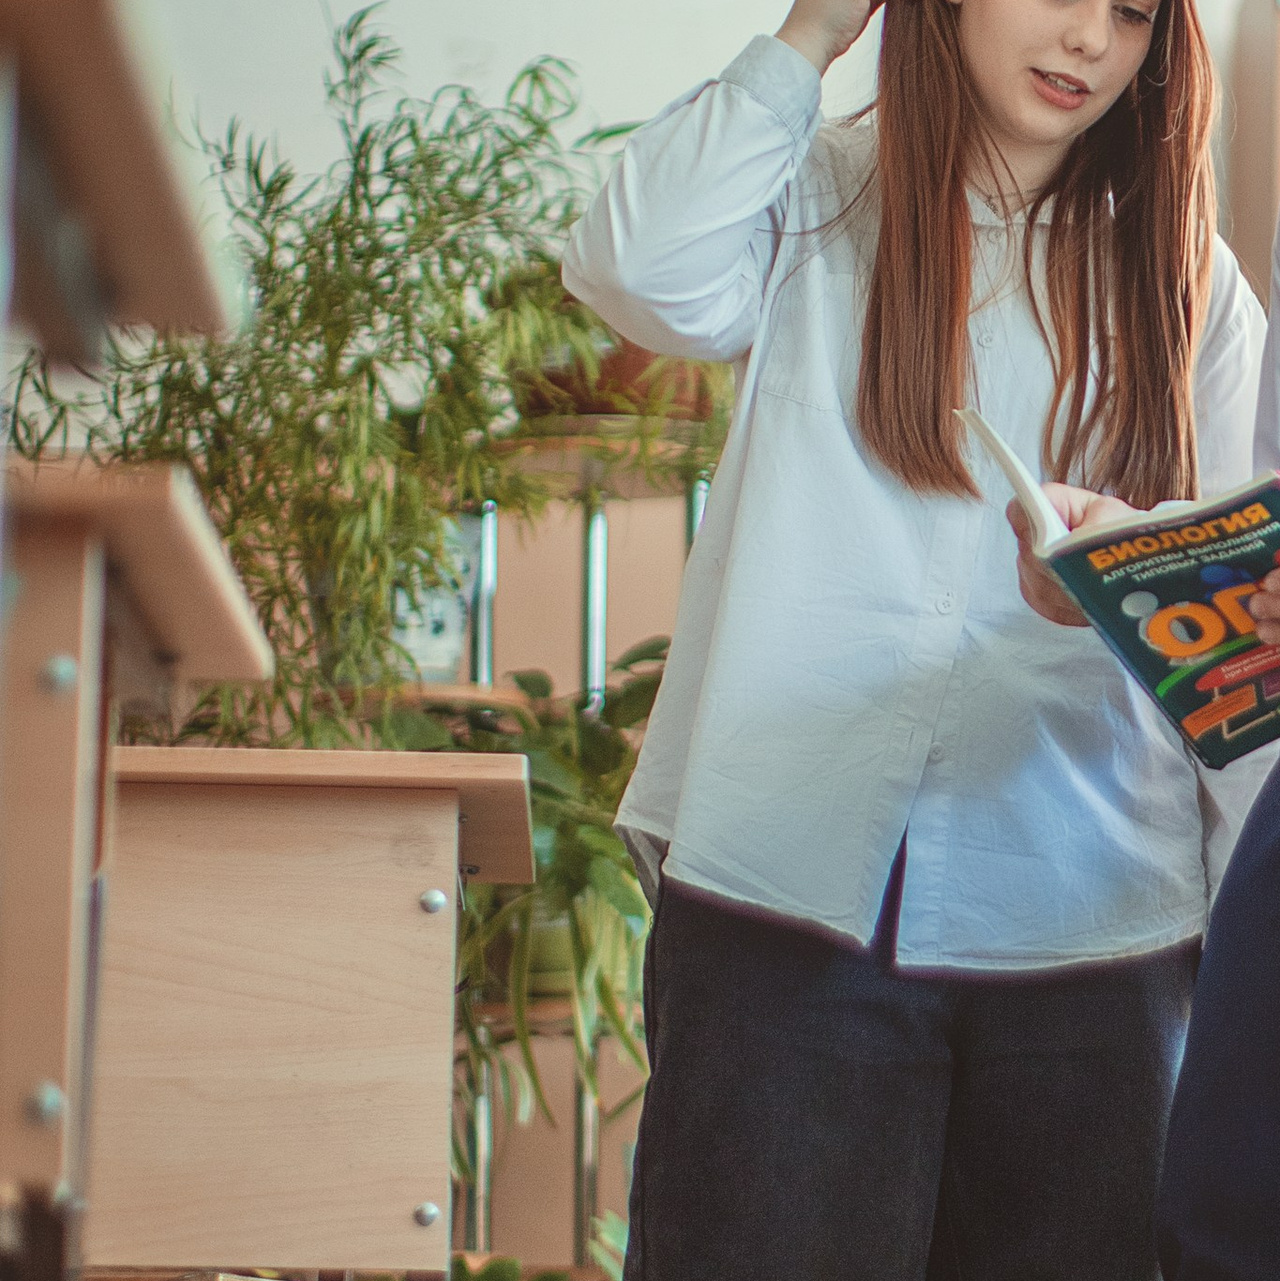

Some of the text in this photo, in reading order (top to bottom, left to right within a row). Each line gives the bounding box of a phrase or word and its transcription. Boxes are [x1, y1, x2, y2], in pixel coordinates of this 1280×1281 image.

[1087, 502, 1271, 570] БИОЛОГИЯ
[1131, 538, 1266, 583] ТИПОВЫХ ЗАДАНИЙ
[1102, 551, 1185, 584] АЛГОРИТМЫ
[1146, 581, 1262, 658] ОГ
